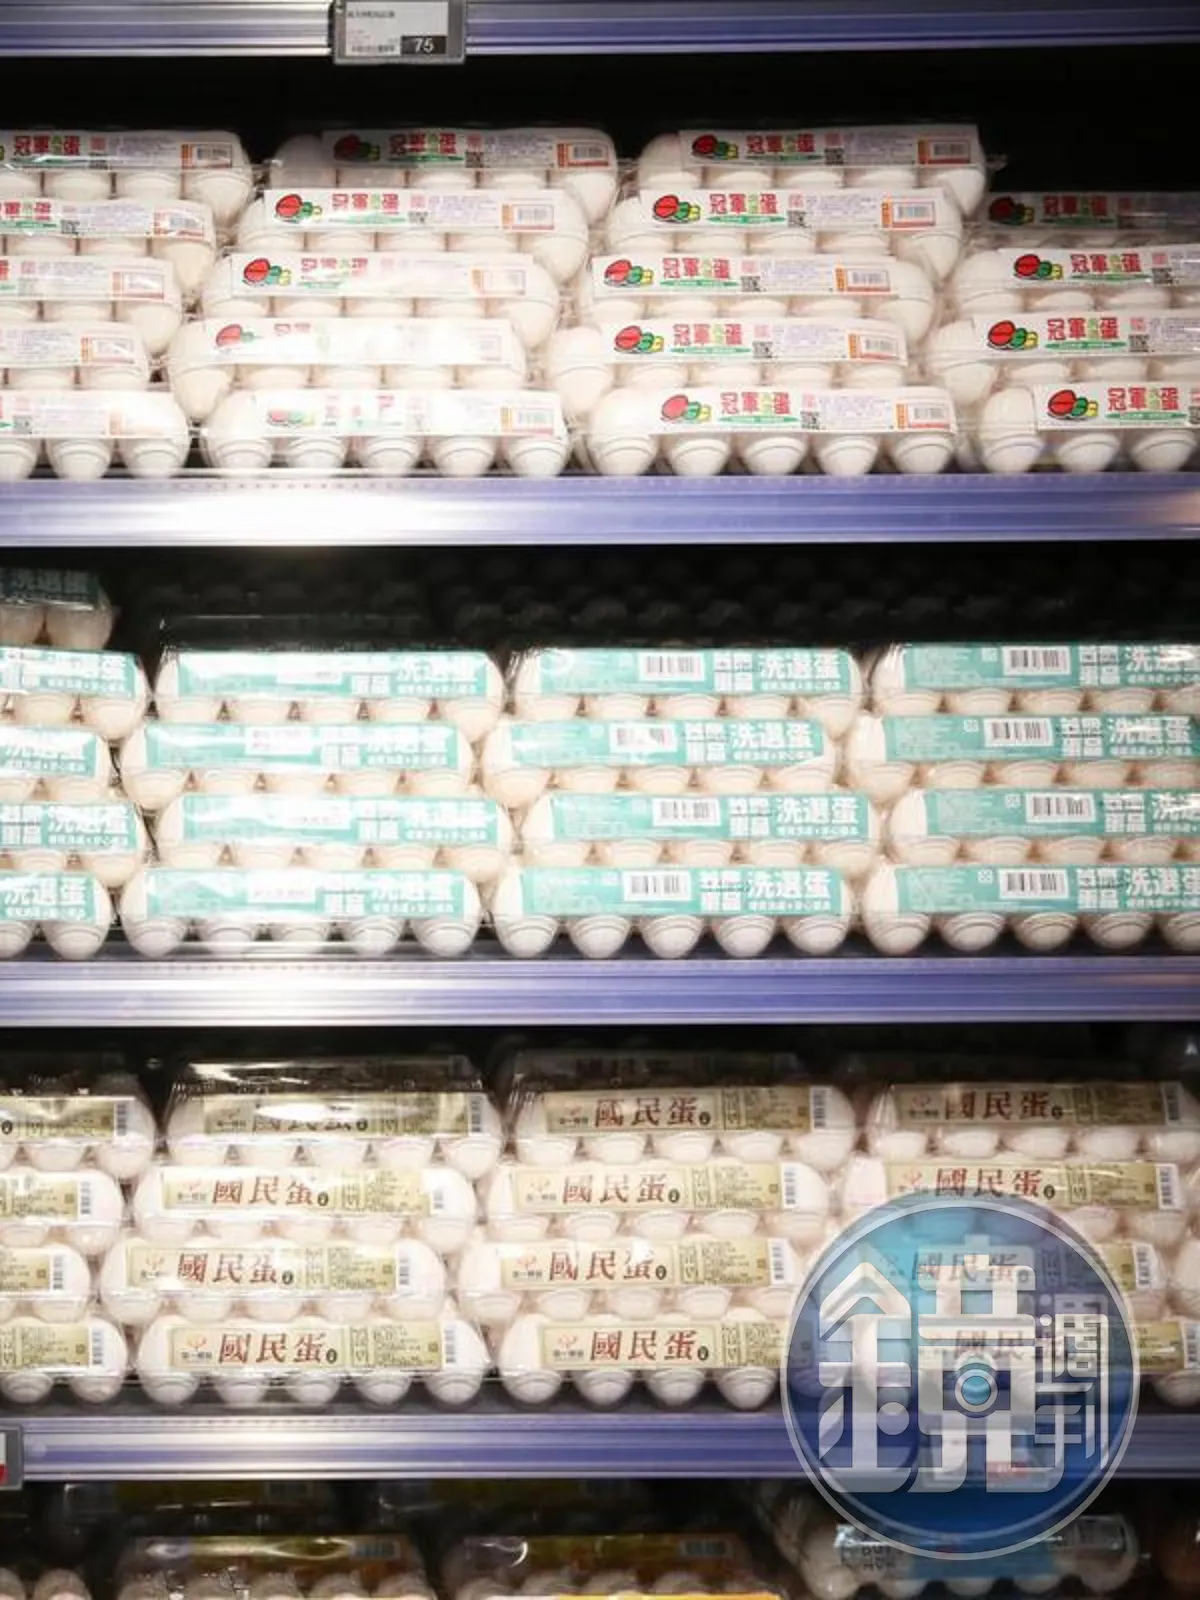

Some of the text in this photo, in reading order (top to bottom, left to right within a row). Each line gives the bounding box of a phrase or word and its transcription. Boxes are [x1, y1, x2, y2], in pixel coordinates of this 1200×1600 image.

[415, 38, 435, 53] 75
[594, 1096, 698, 1128] 國民蛋
[945, 1090, 1050, 1121] 國民蛋
[211, 1176, 314, 1207] 國民蛋
[562, 1173, 667, 1205] 國民蛋
[936, 1167, 1042, 1198] 國民蛋
[177, 1252, 278, 1285] 國民蛋
[549, 1250, 651, 1281] 國民蛋
[217, 1331, 326, 1364] 國民蛋
[590, 1329, 696, 1362] 國民蛋
